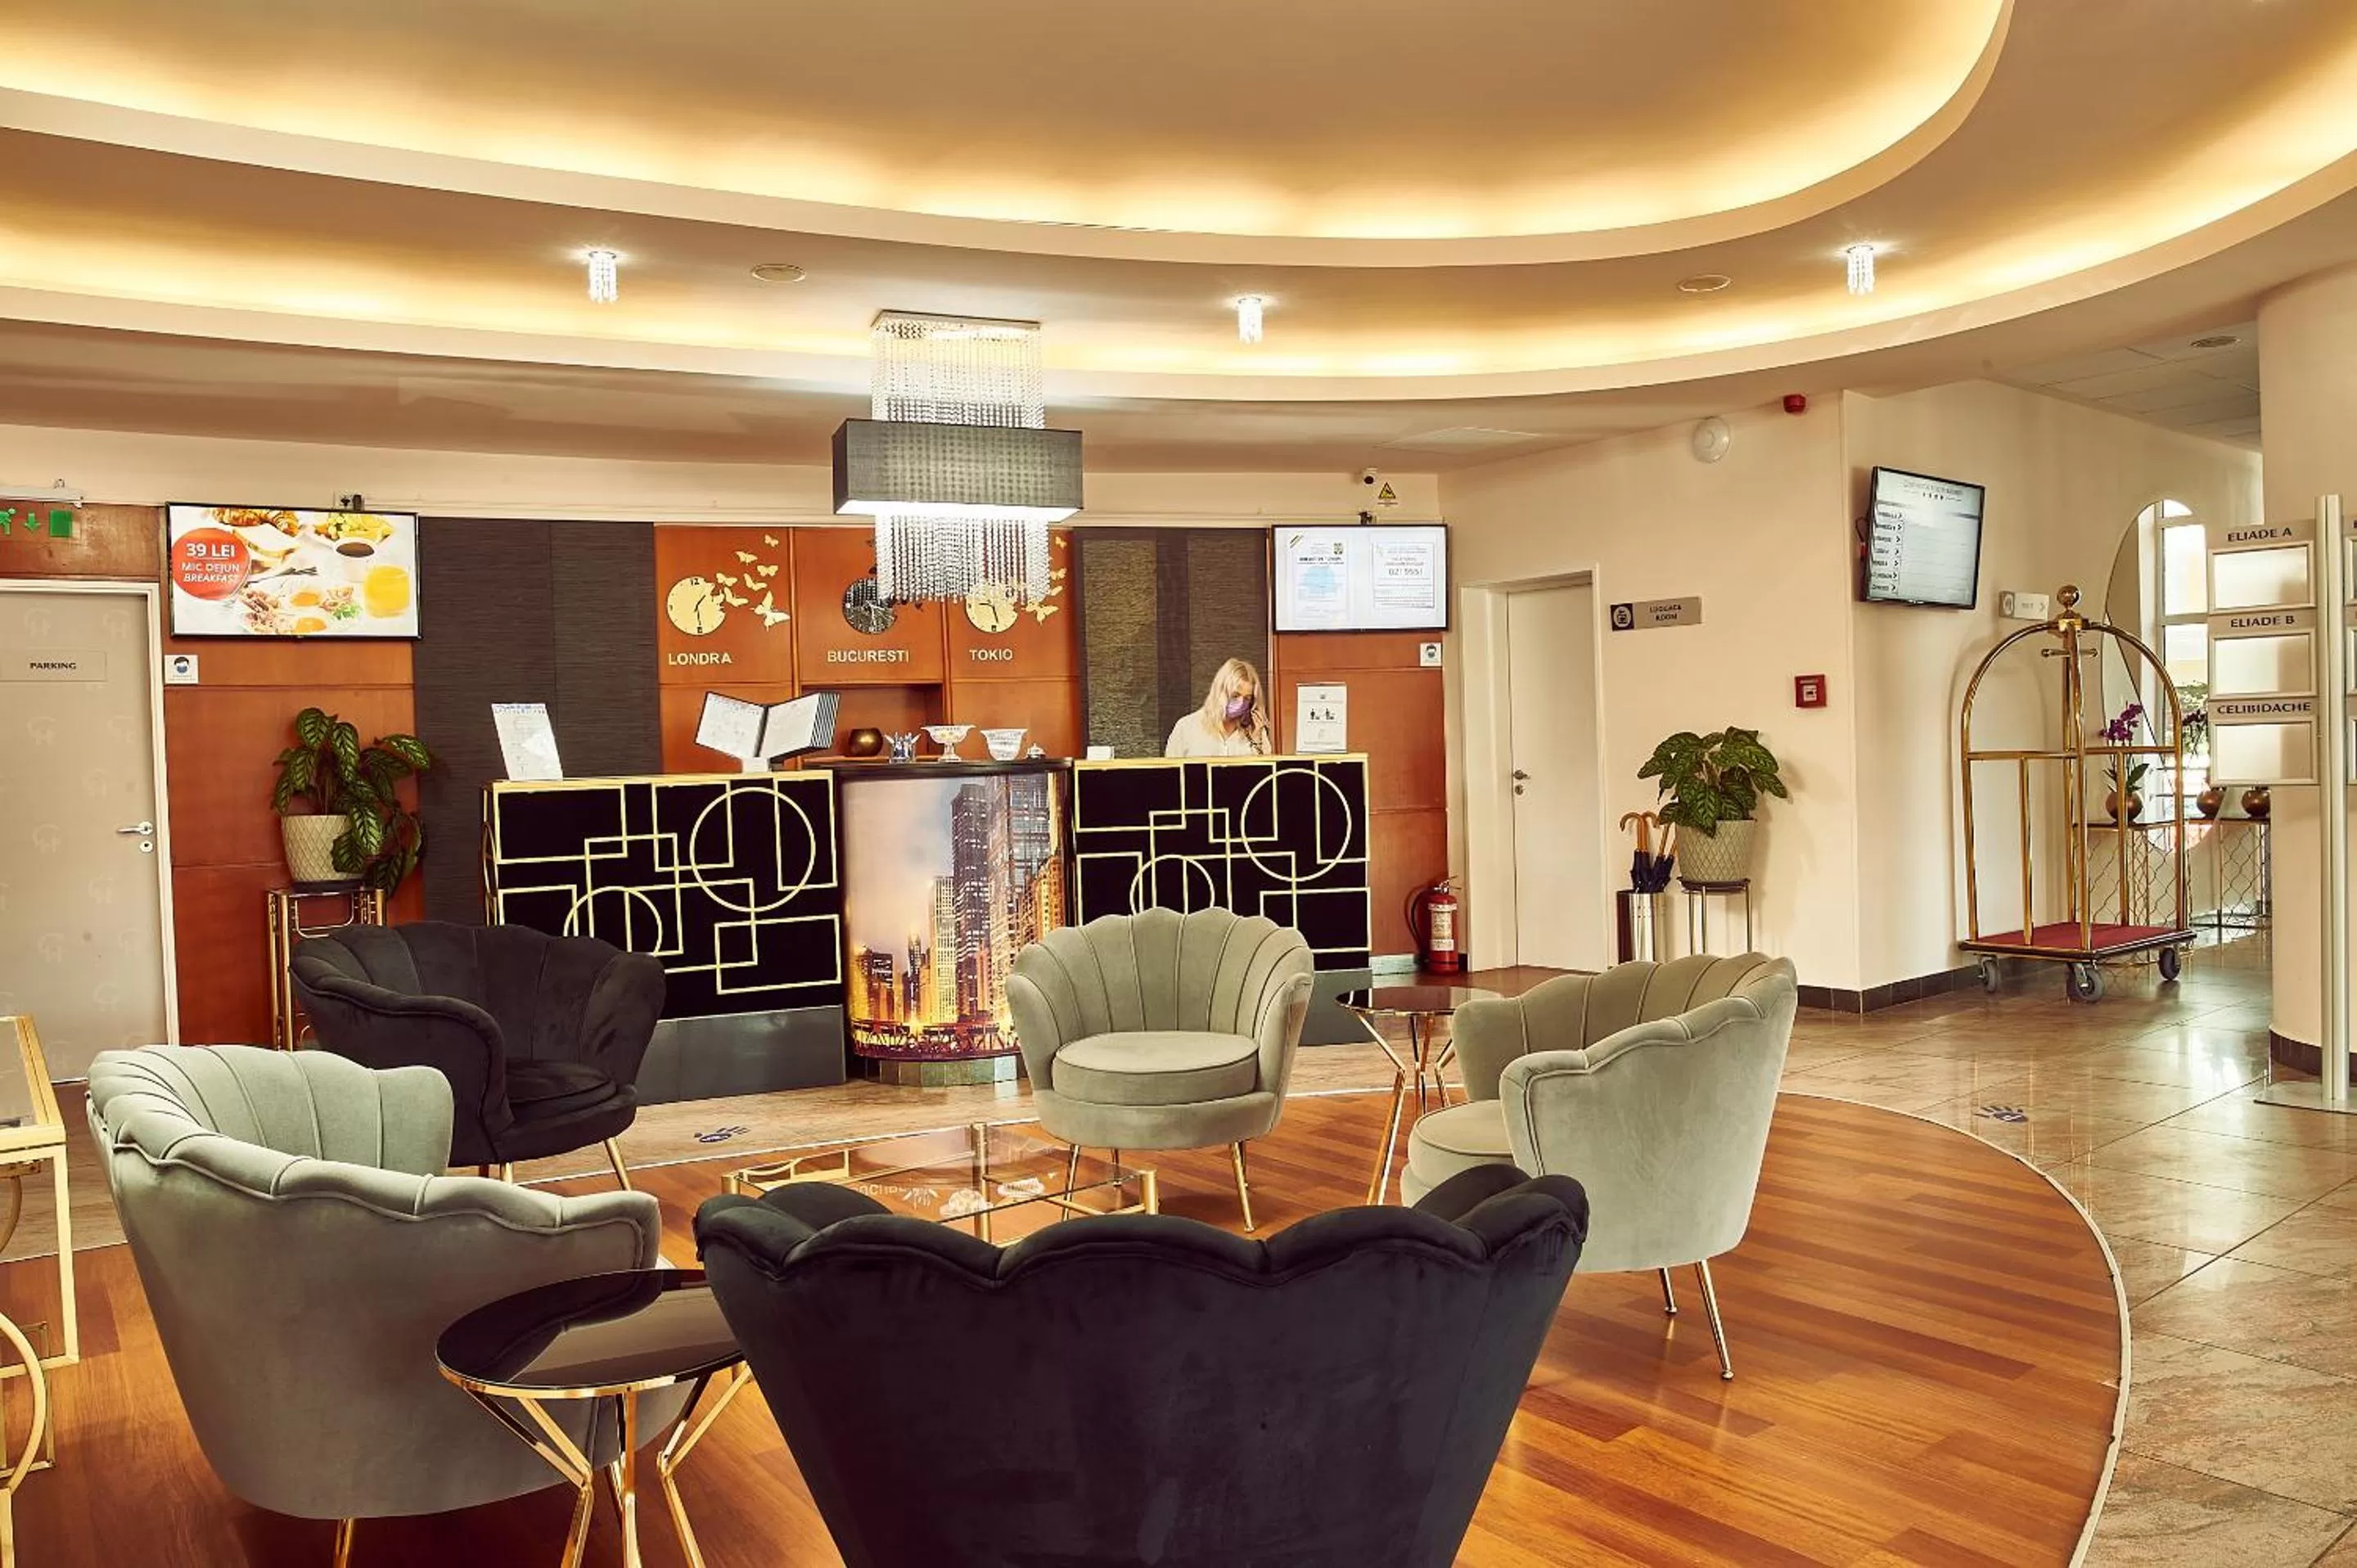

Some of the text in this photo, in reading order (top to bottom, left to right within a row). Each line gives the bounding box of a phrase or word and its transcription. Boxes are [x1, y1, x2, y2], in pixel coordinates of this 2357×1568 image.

[2228, 527, 2292, 542] ELIADE A
[186, 543, 236, 557] 39 LEI
[182, 561, 240, 573] MIC DEJUN
[183, 573, 240, 583] BREAKFAST
[2230, 615, 2295, 629] ELIADE B
[668, 652, 732, 665] LONDRA
[827, 649, 909, 663] BUCURESTI
[969, 648, 1013, 661] TOKIO
[2216, 701, 2311, 715] CELIBIDACHE
